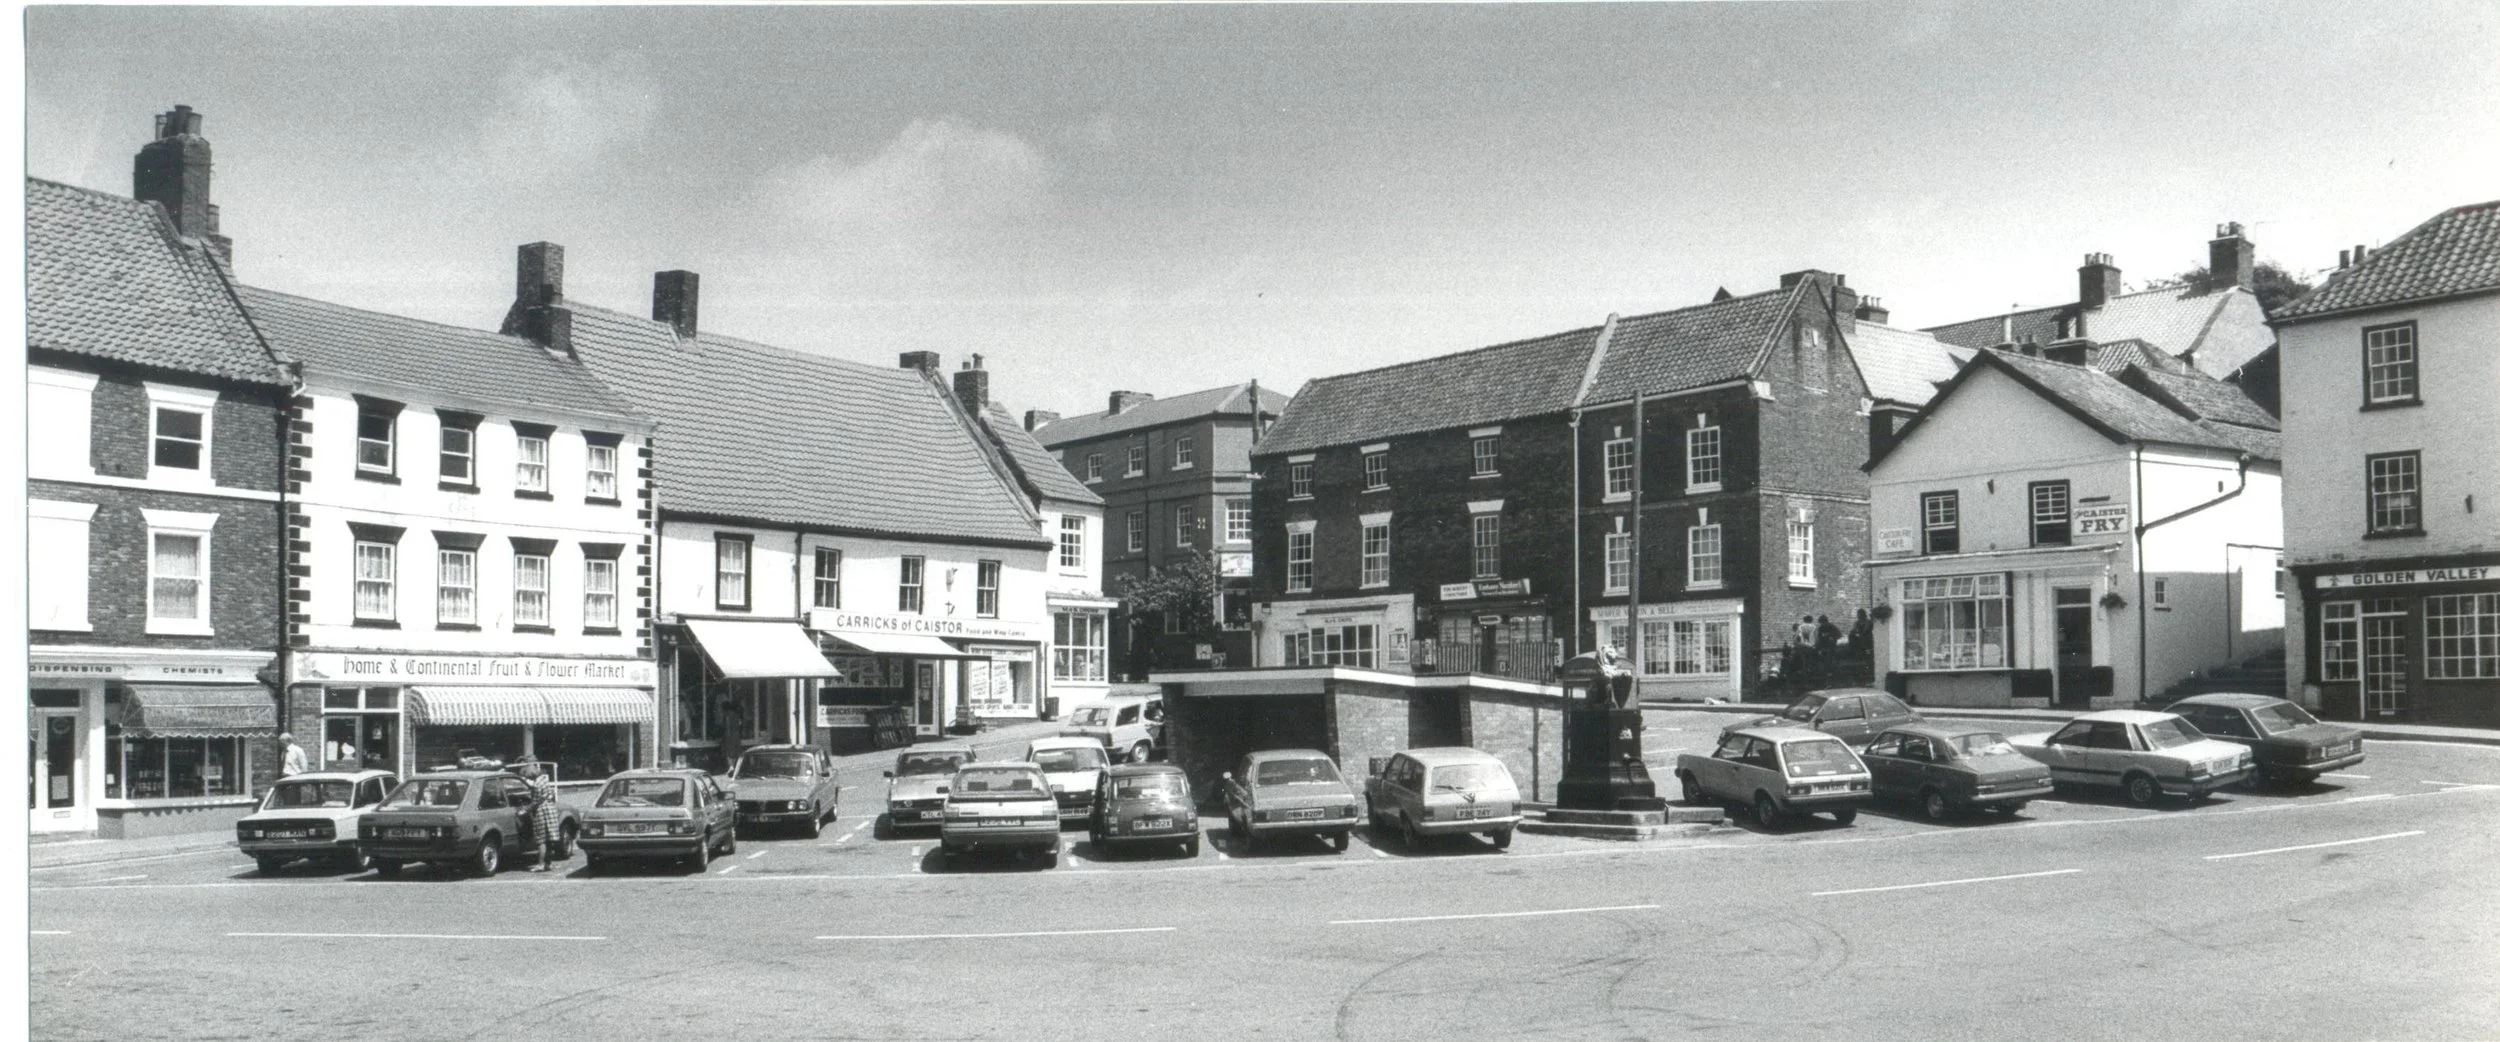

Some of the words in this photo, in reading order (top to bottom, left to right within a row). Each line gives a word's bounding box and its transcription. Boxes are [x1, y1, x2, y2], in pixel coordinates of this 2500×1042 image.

[2083, 508, 2127, 517] CAISTOR
[2080, 517, 2124, 533] FRY
[2352, 571, 2416, 585] GOLDEN
[2426, 568, 2488, 581] VALLEY
[837, 614, 898, 631] CARRICKS
[901, 619, 911, 631] of
[915, 619, 963, 634] CAISTOR
[29, 664, 113, 673] DISPENSING
[344, 655, 383, 675] Home
[390, 657, 399, 675] &
[406, 658, 482, 677] Continental
[488, 659, 519, 677] Fruit
[525, 660, 532, 677] &
[538, 661, 579, 678] Flower
[584, 662, 625, 679] Market
